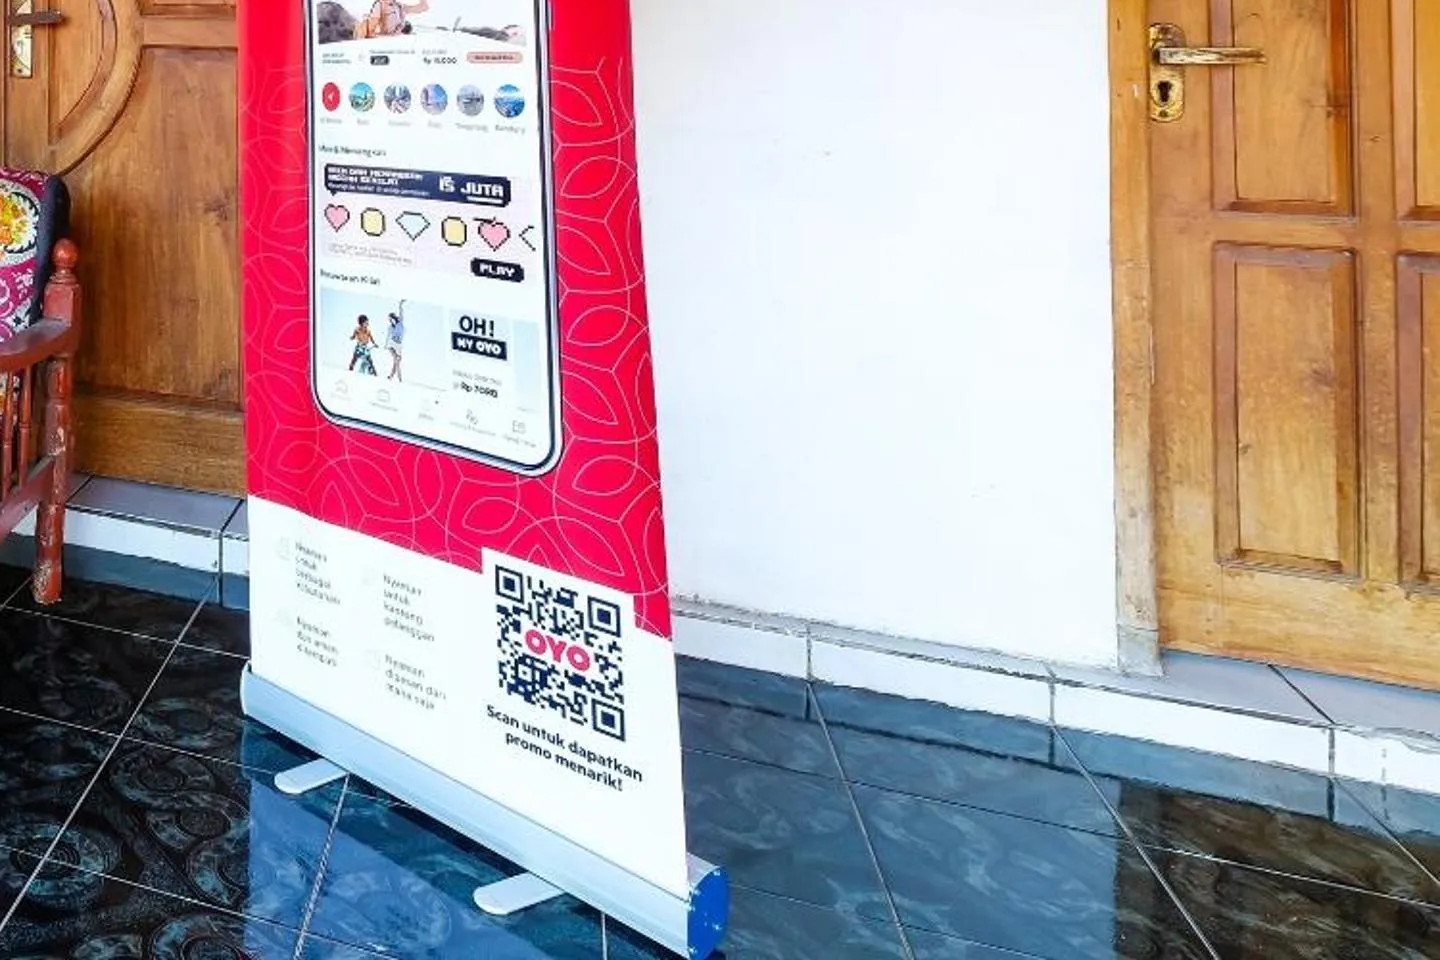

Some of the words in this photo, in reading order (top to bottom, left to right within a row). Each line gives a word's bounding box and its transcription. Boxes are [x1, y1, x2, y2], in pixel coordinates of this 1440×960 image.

[460, 182, 504, 197] JUTA
[479, 262, 516, 278] PLAY
[456, 337, 473, 351] MY
[475, 342, 502, 356] OYO
[524, 629, 590, 672] OYO
[487, 705, 519, 729] Scan
[522, 722, 566, 749] untuk
[568, 739, 643, 782] dapatkan
[505, 732, 552, 760] promo
[555, 754, 624, 792] menarik!
